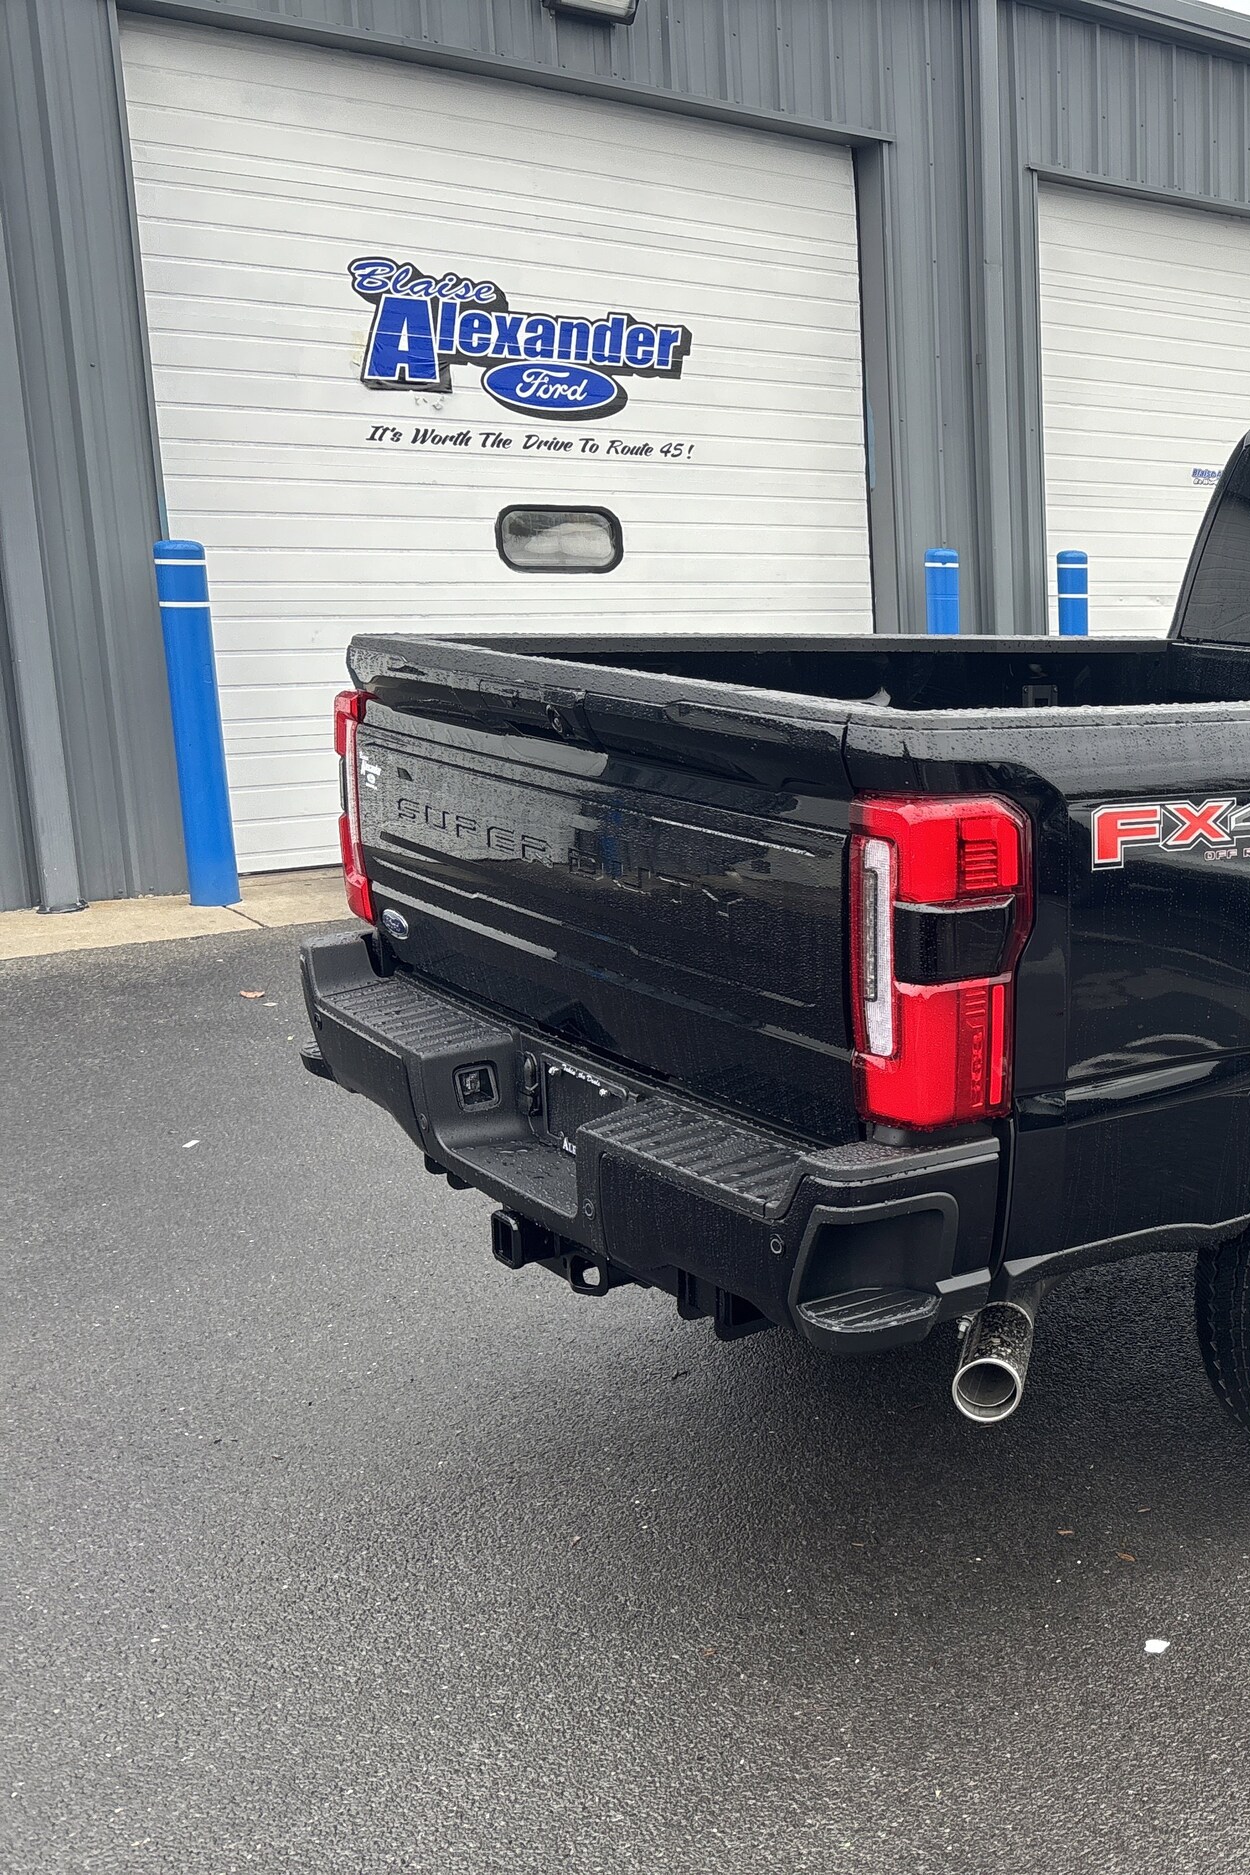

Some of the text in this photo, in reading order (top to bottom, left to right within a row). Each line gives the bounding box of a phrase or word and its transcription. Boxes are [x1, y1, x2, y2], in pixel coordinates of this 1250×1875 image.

[350, 258, 498, 302] Blaise
[364, 293, 686, 383] Alexander
[515, 368, 588, 402] Ford
[366, 425, 403, 443] It's
[411, 427, 473, 448] Worth
[479, 432, 512, 450] The
[522, 435, 573, 453] Drive
[580, 438, 600, 454] To
[606, 440, 654, 457] Route
[398, 798, 552, 868] SUPER
[1204, 848, 1238, 861] OFF
